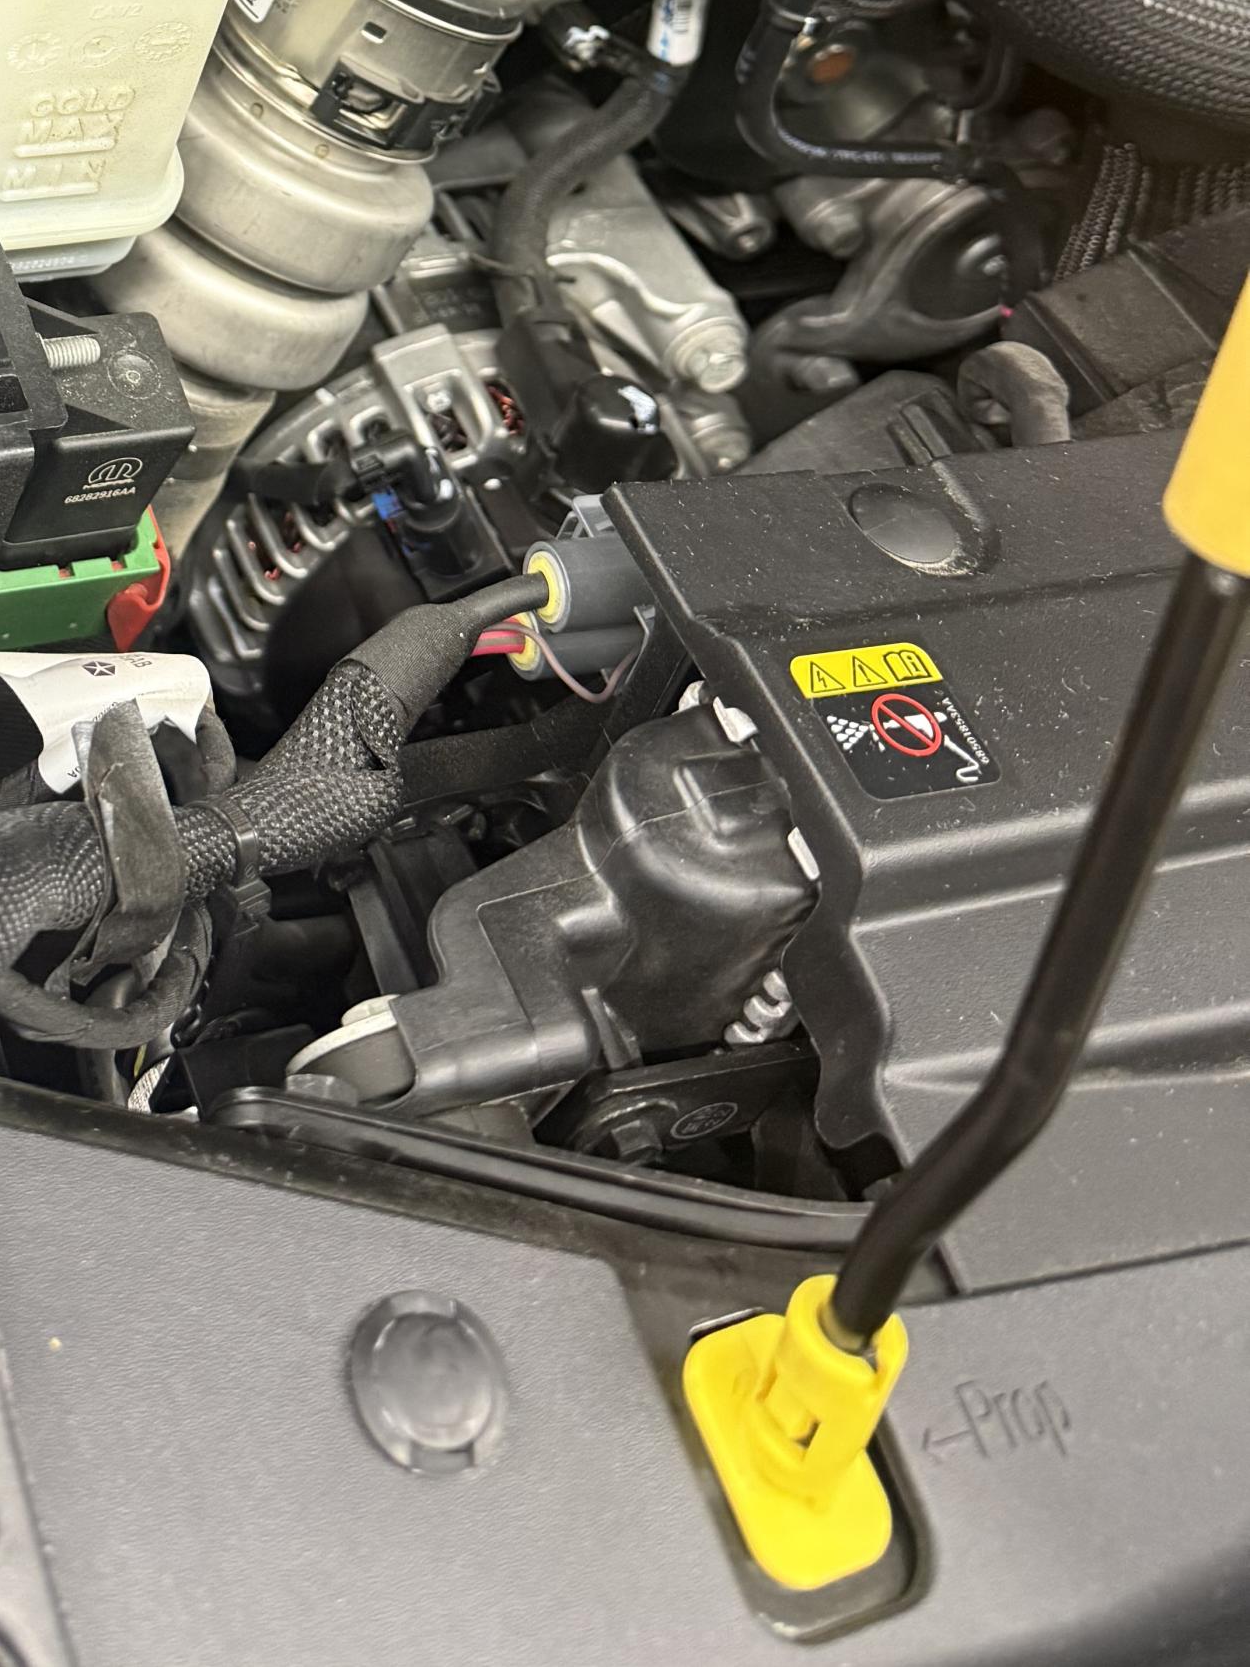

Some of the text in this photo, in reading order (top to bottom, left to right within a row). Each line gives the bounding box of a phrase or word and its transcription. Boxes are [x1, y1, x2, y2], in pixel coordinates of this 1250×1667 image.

[28, 84, 137, 118] COLD
[18, 111, 125, 143] MAX
[954, 1380, 1072, 1460] Prop
